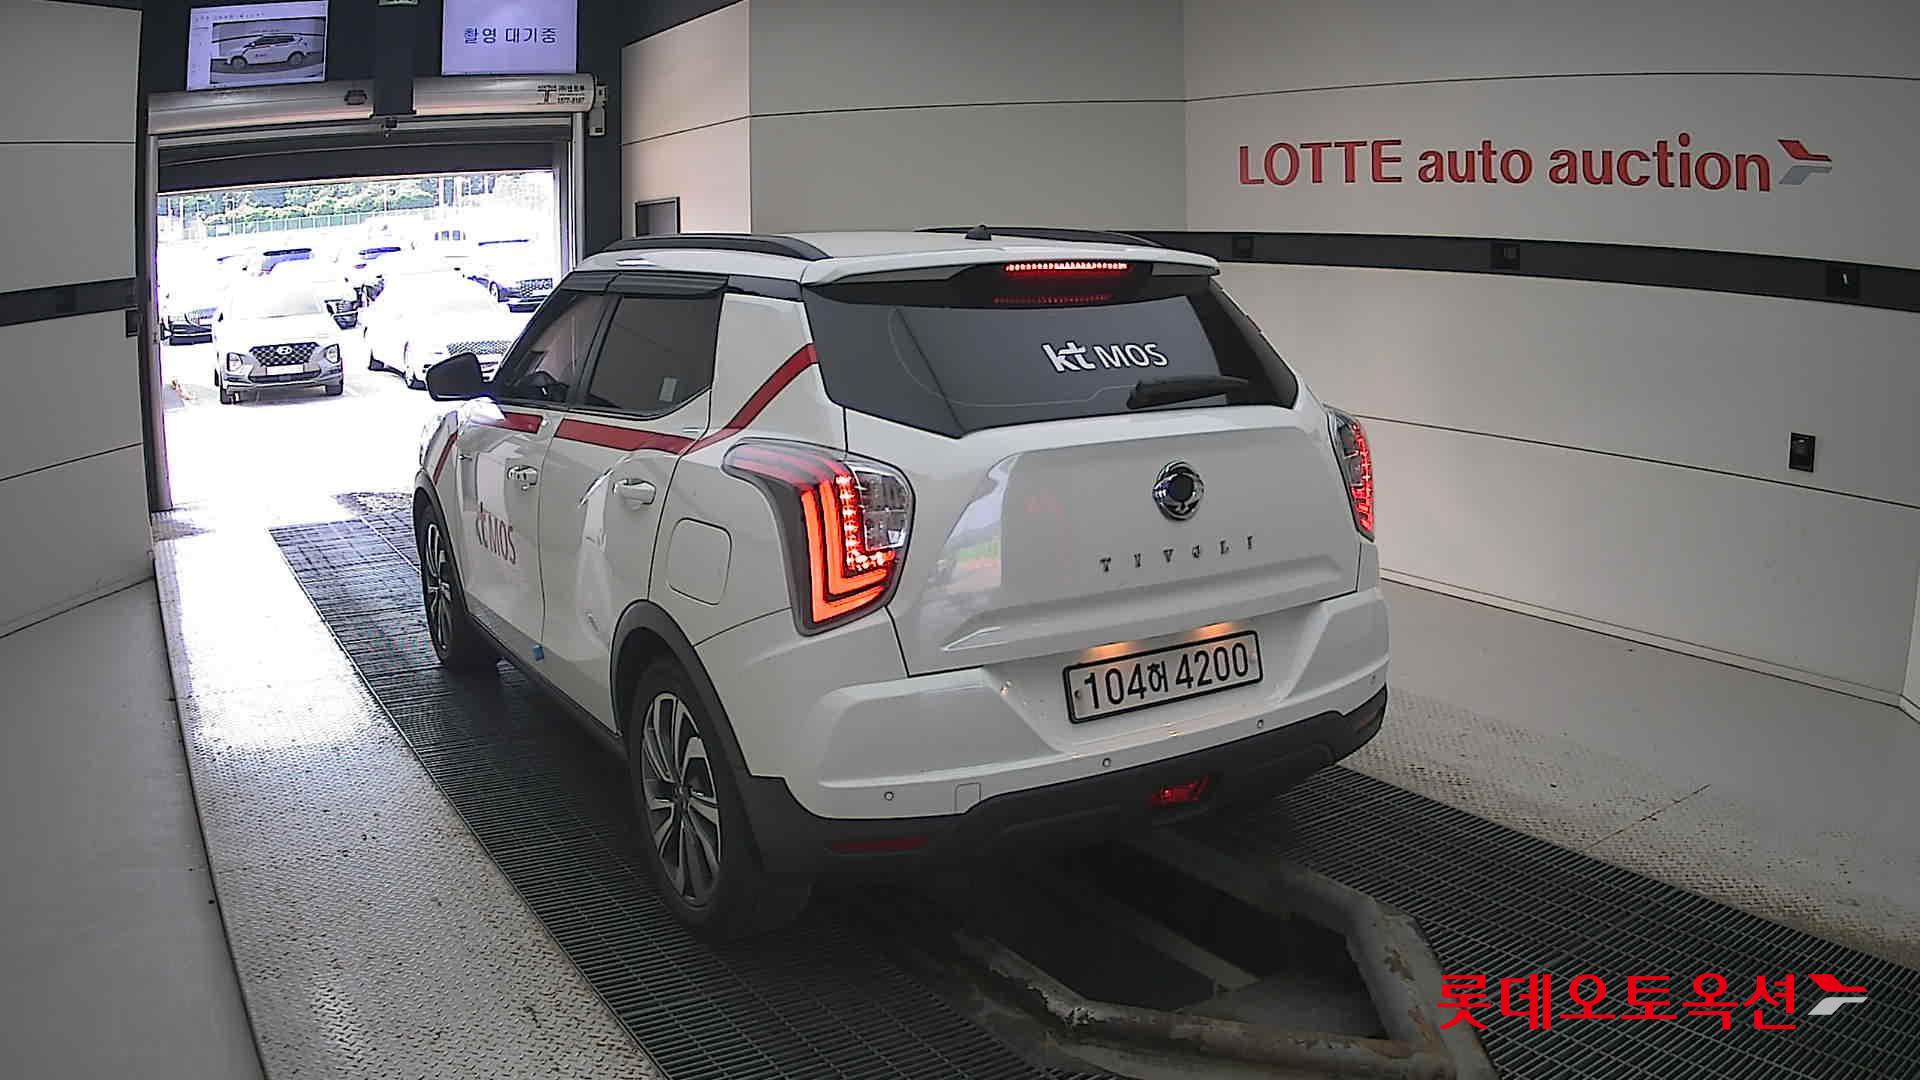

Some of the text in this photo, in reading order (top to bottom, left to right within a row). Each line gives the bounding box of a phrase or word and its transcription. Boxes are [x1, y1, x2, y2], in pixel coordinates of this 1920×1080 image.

[505, 27, 556, 44] 대기중
[1238, 132, 1771, 192] LOTTE auto auction
[1042, 341, 1168, 372] kt MOS
[488, 511, 516, 565] MOS
[1099, 535, 1254, 573] TIVOLI
[1084, 642, 1249, 709] 104허 4200
